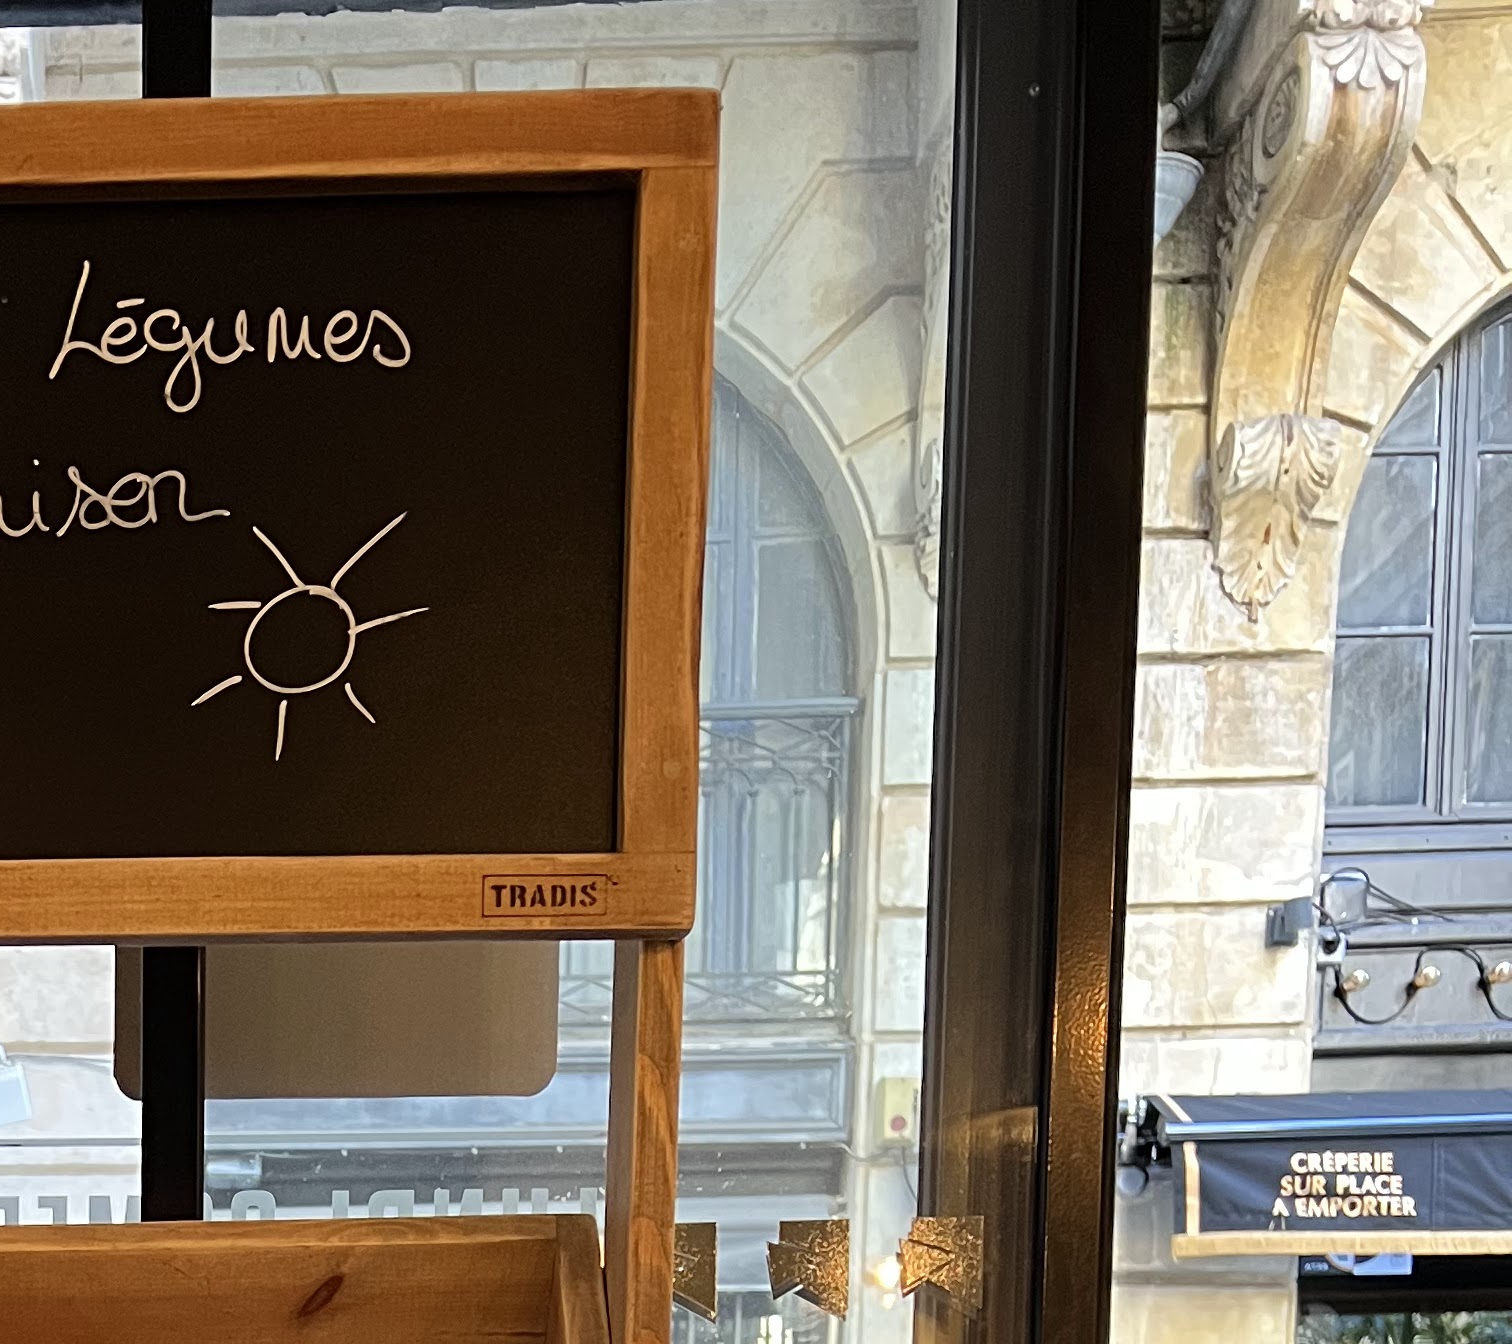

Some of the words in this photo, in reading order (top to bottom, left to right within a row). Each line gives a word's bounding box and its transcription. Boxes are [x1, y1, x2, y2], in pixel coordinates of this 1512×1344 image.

[490, 883, 599, 908] TRADIS
[1280, 1174, 1327, 1197] SUR
[1335, 1174, 1403, 1196] PLACE
[1294, 1196, 1417, 1218] EMPORTER
